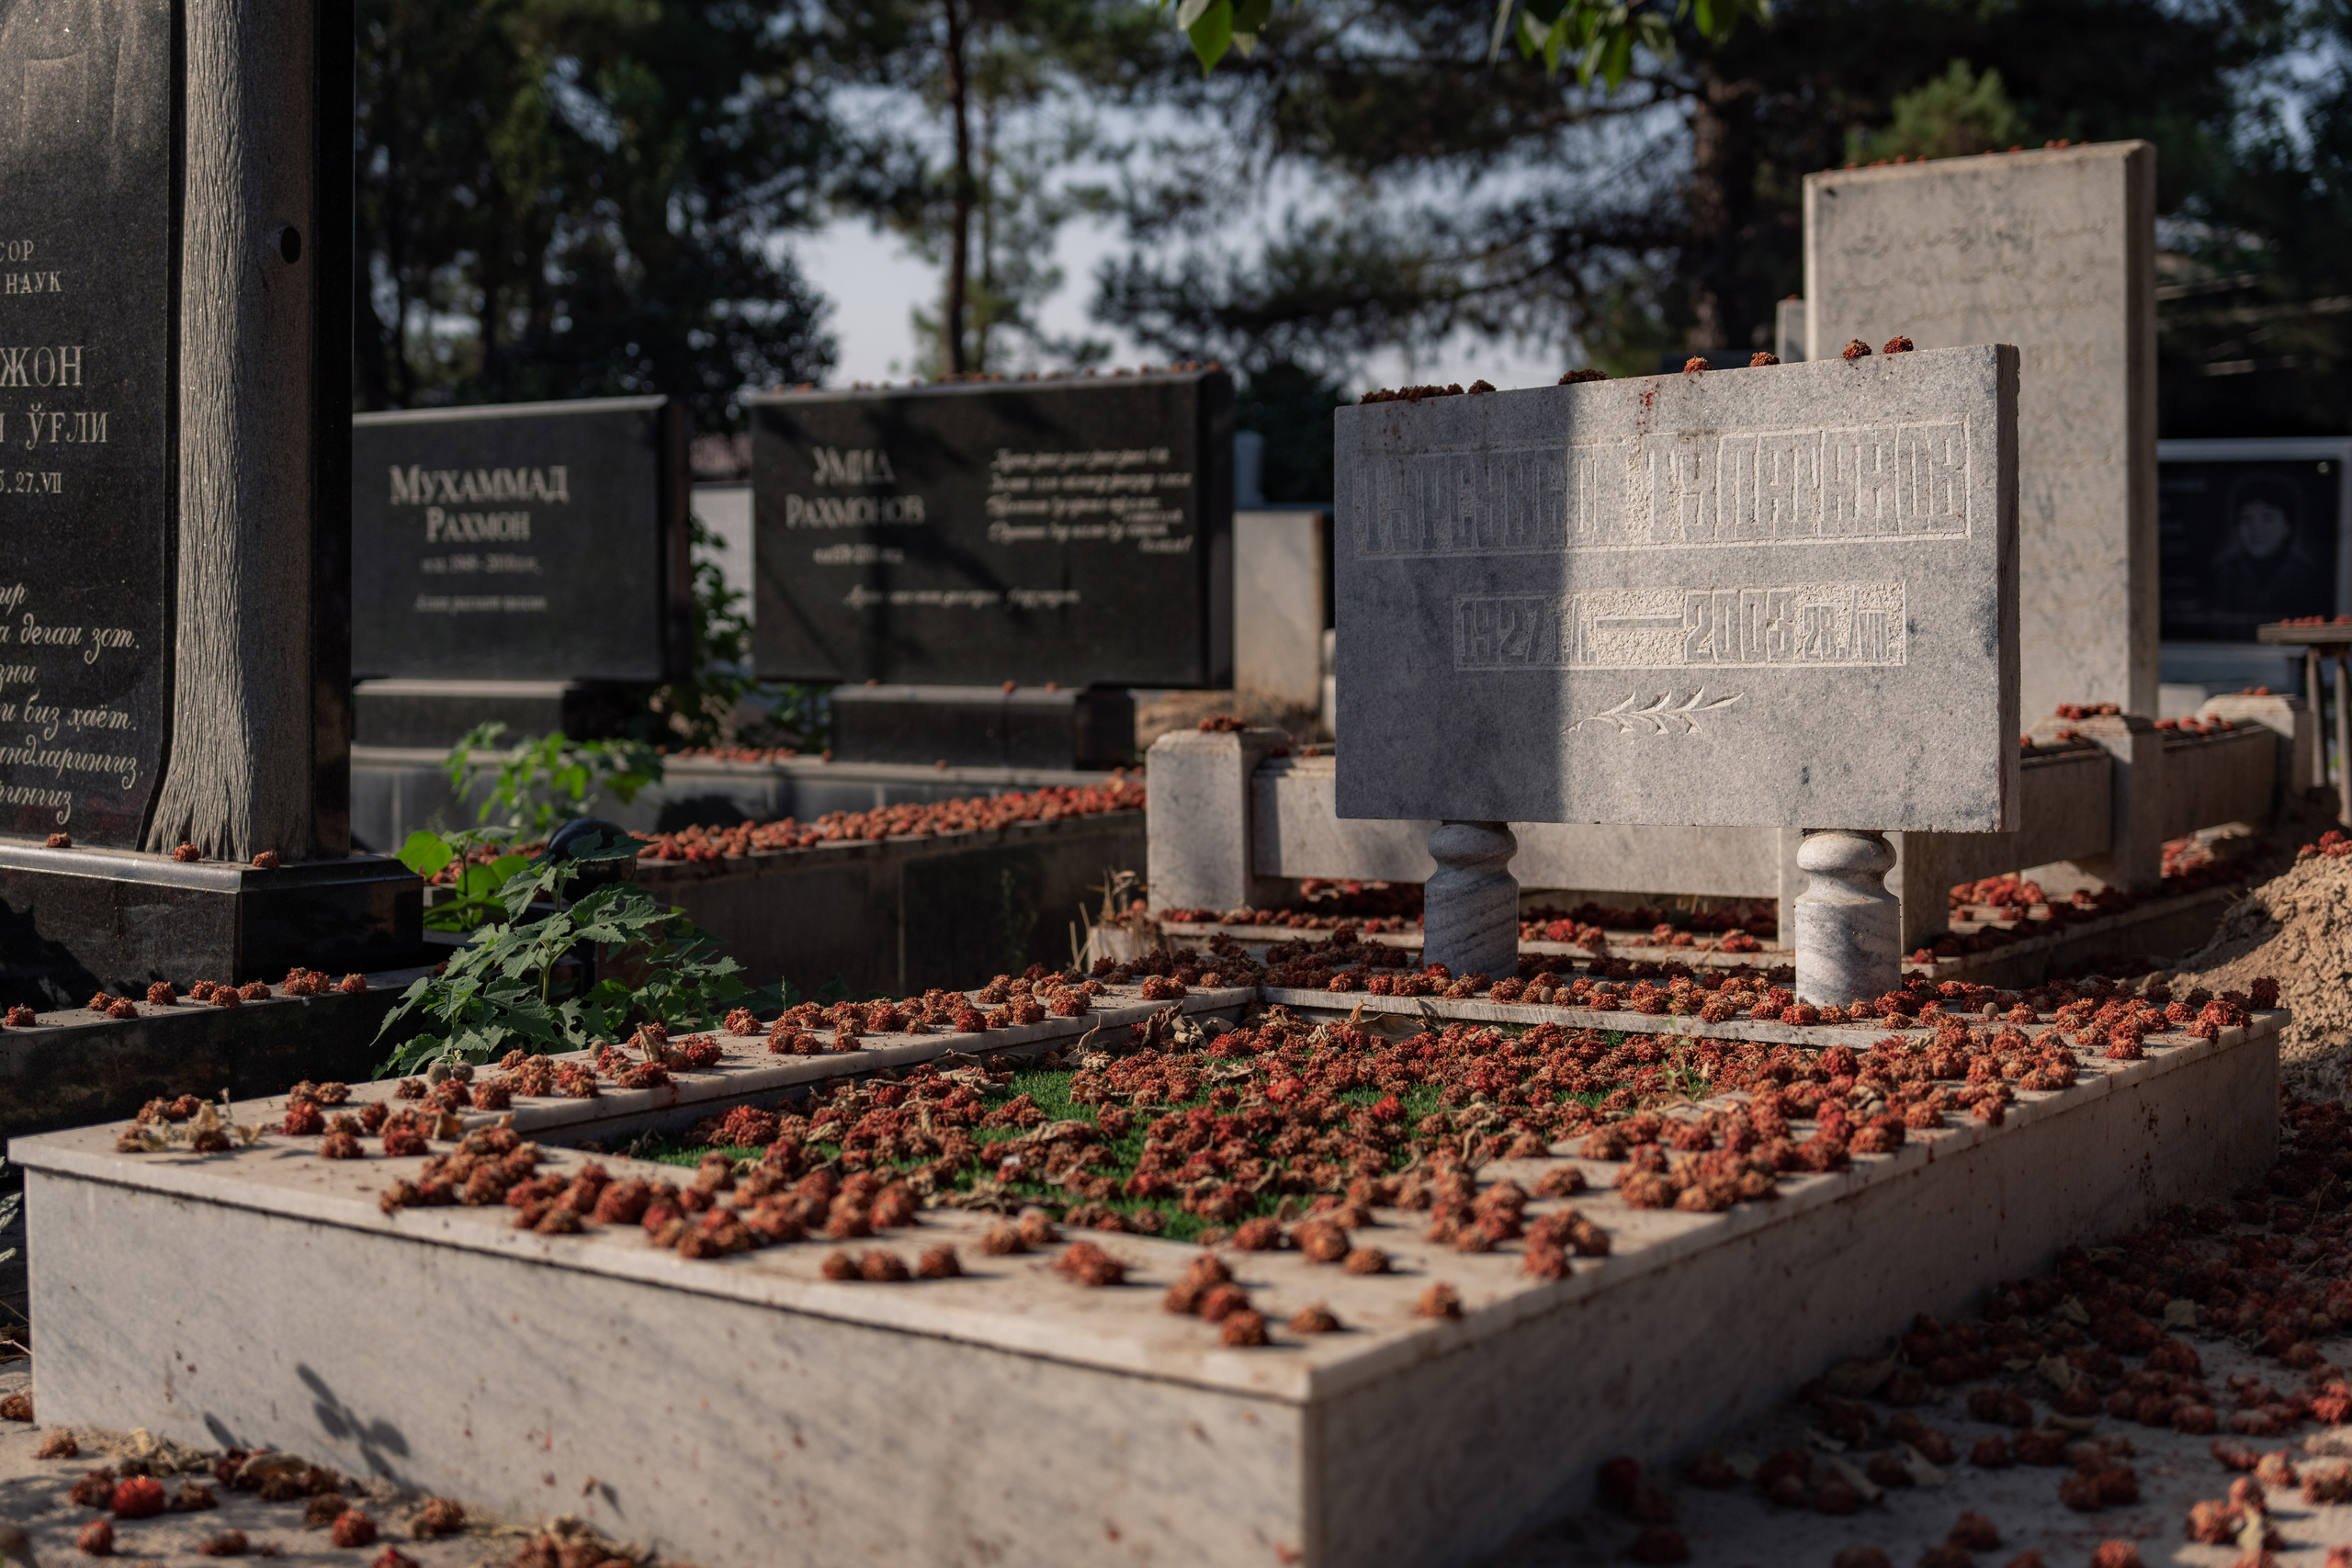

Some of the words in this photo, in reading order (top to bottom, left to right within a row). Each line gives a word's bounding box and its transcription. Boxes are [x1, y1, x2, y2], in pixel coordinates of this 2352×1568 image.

[6, 271, 62, 294] НАУК
[21, 613, 82, 645] деган
[85, 627, 140, 665] зот.
[1687, 589, 1795, 662] 2003
[25, 688, 61, 741] биз
